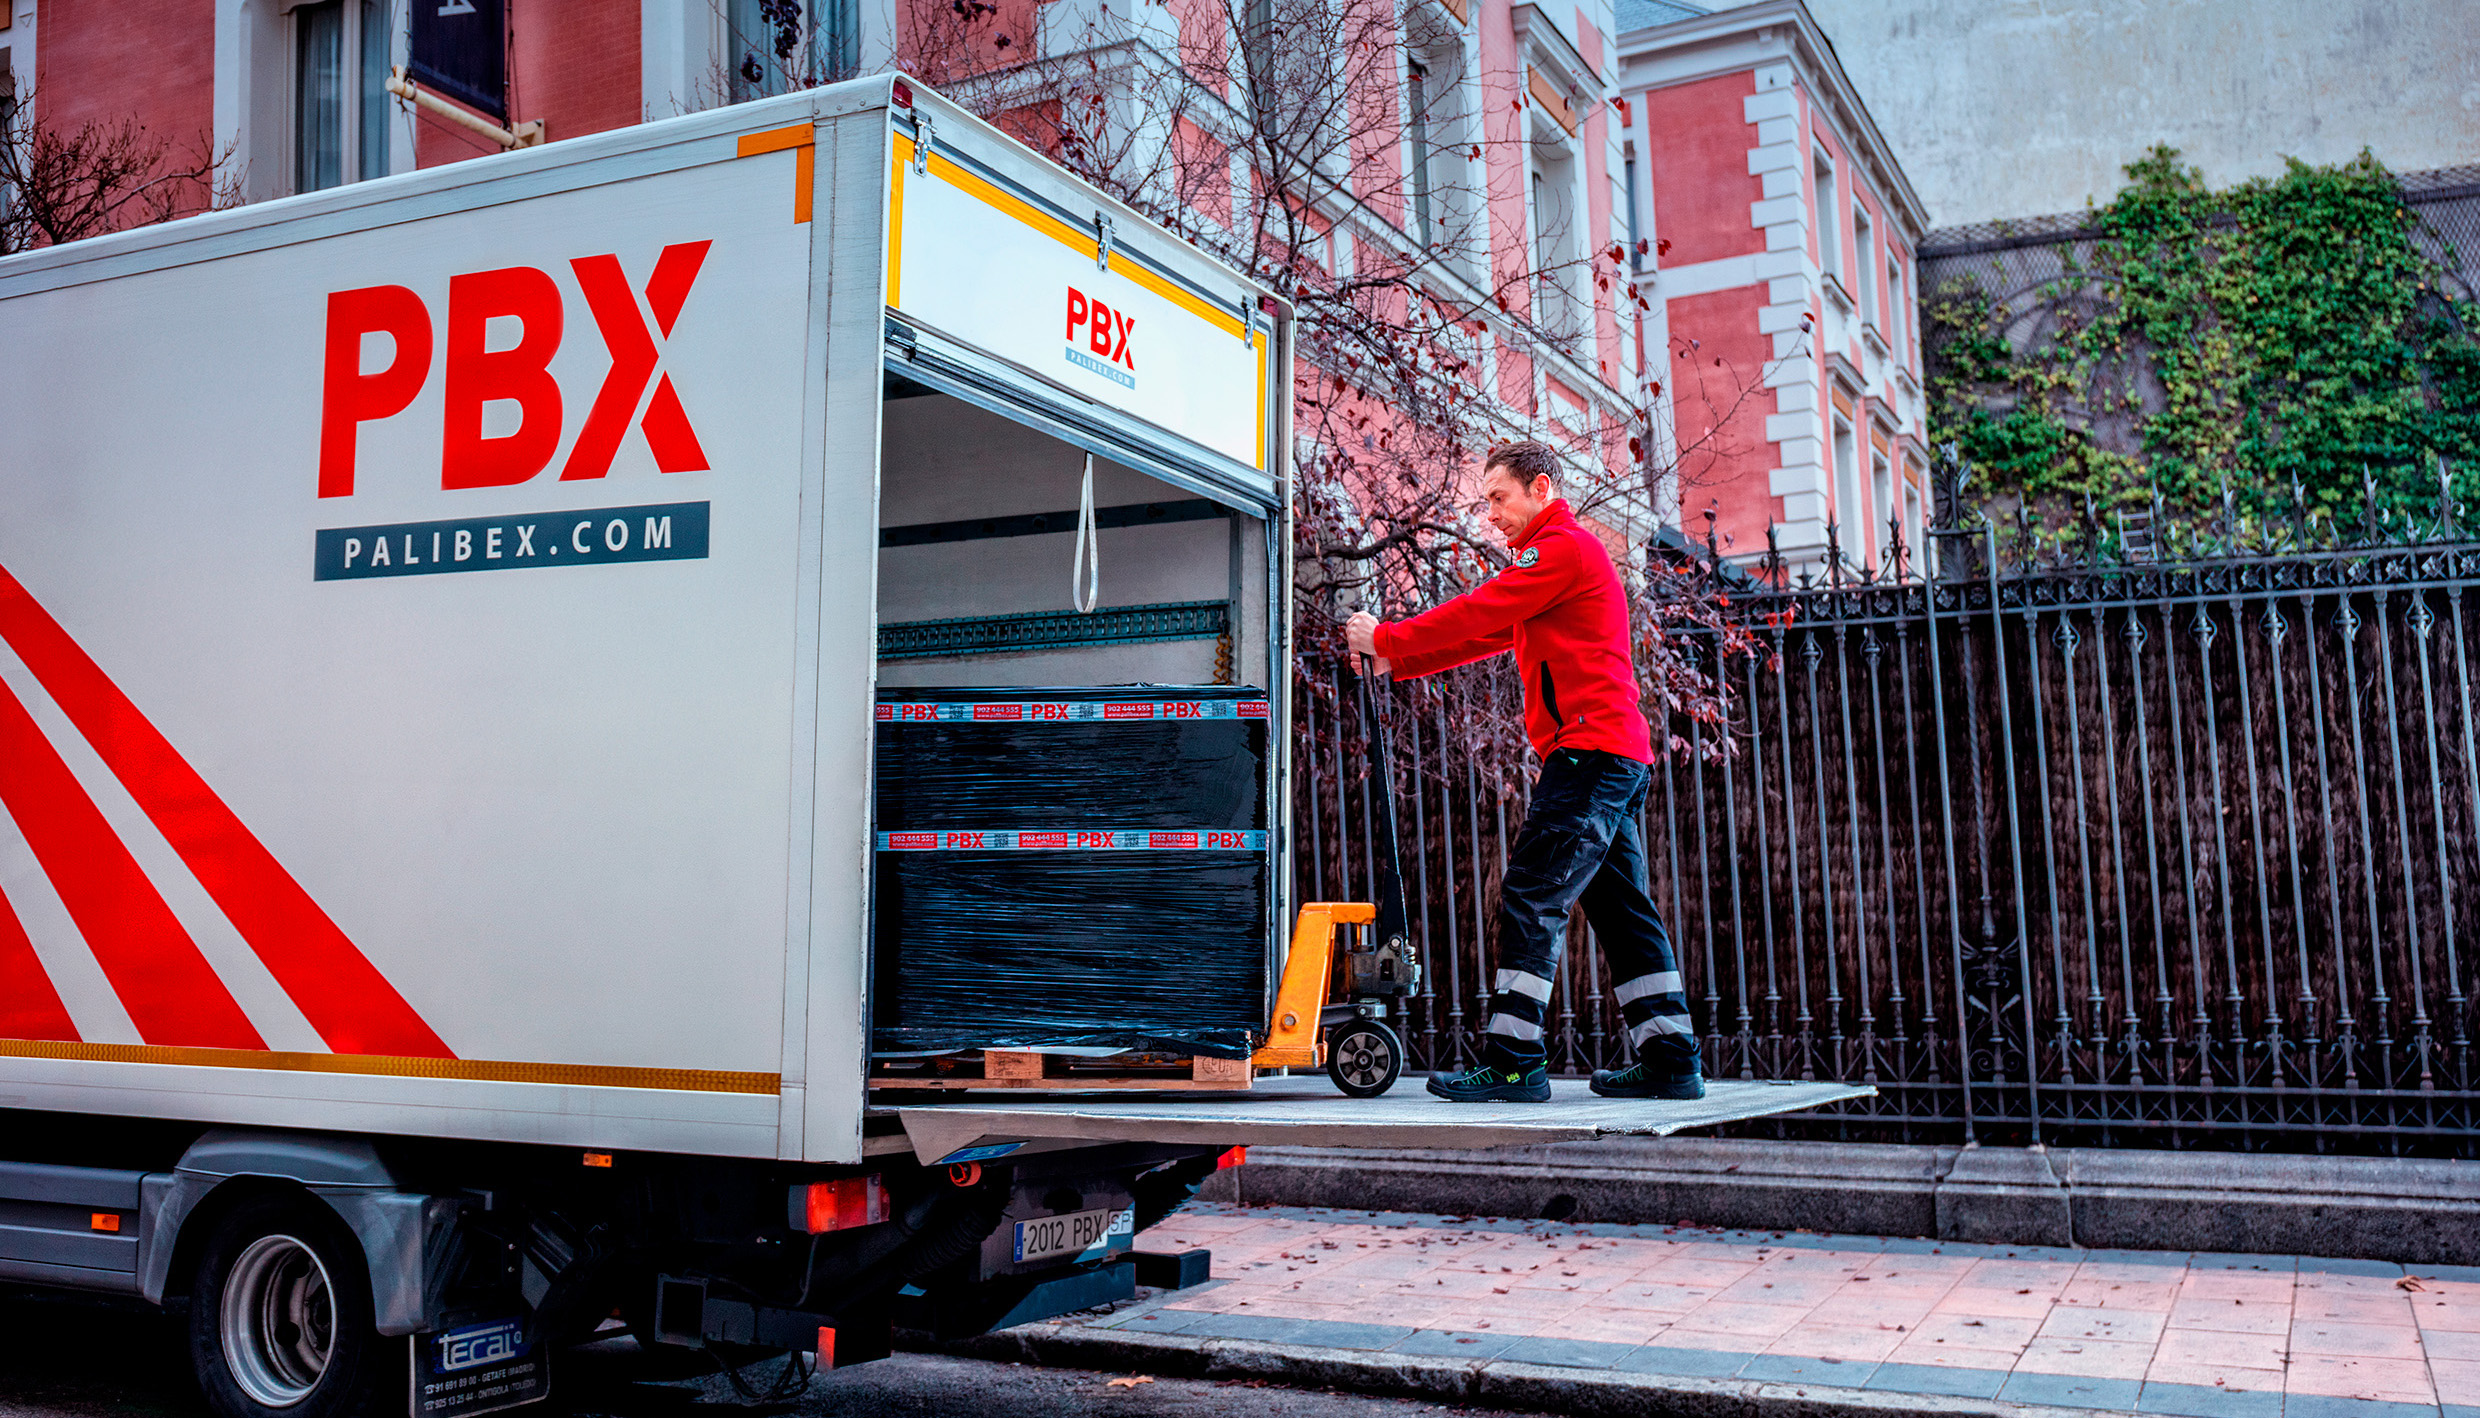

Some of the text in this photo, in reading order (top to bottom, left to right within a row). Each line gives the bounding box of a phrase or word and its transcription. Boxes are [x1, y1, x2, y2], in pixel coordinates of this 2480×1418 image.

[1066, 285, 1135, 371] PBX
[318, 239, 713, 498] PBX
[1070, 351, 1131, 386] PALIBEX.COM
[344, 516, 672, 569] PALIBEX.COM
[902, 704, 940, 720] PBX
[1031, 704, 1069, 720] PBX
[1163, 702, 1202, 718] PBX
[947, 832, 985, 848] PBX
[1077, 832, 1115, 848] PBX
[1207, 832, 1246, 848] PBX
[1111, 1213, 1131, 1232] SP
[1027, 1220, 1065, 1254] 2012
[1073, 1214, 1103, 1246] PBX
[435, 1382, 444, 1393] 91
[482, 1368, 506, 1382] GETAFE
